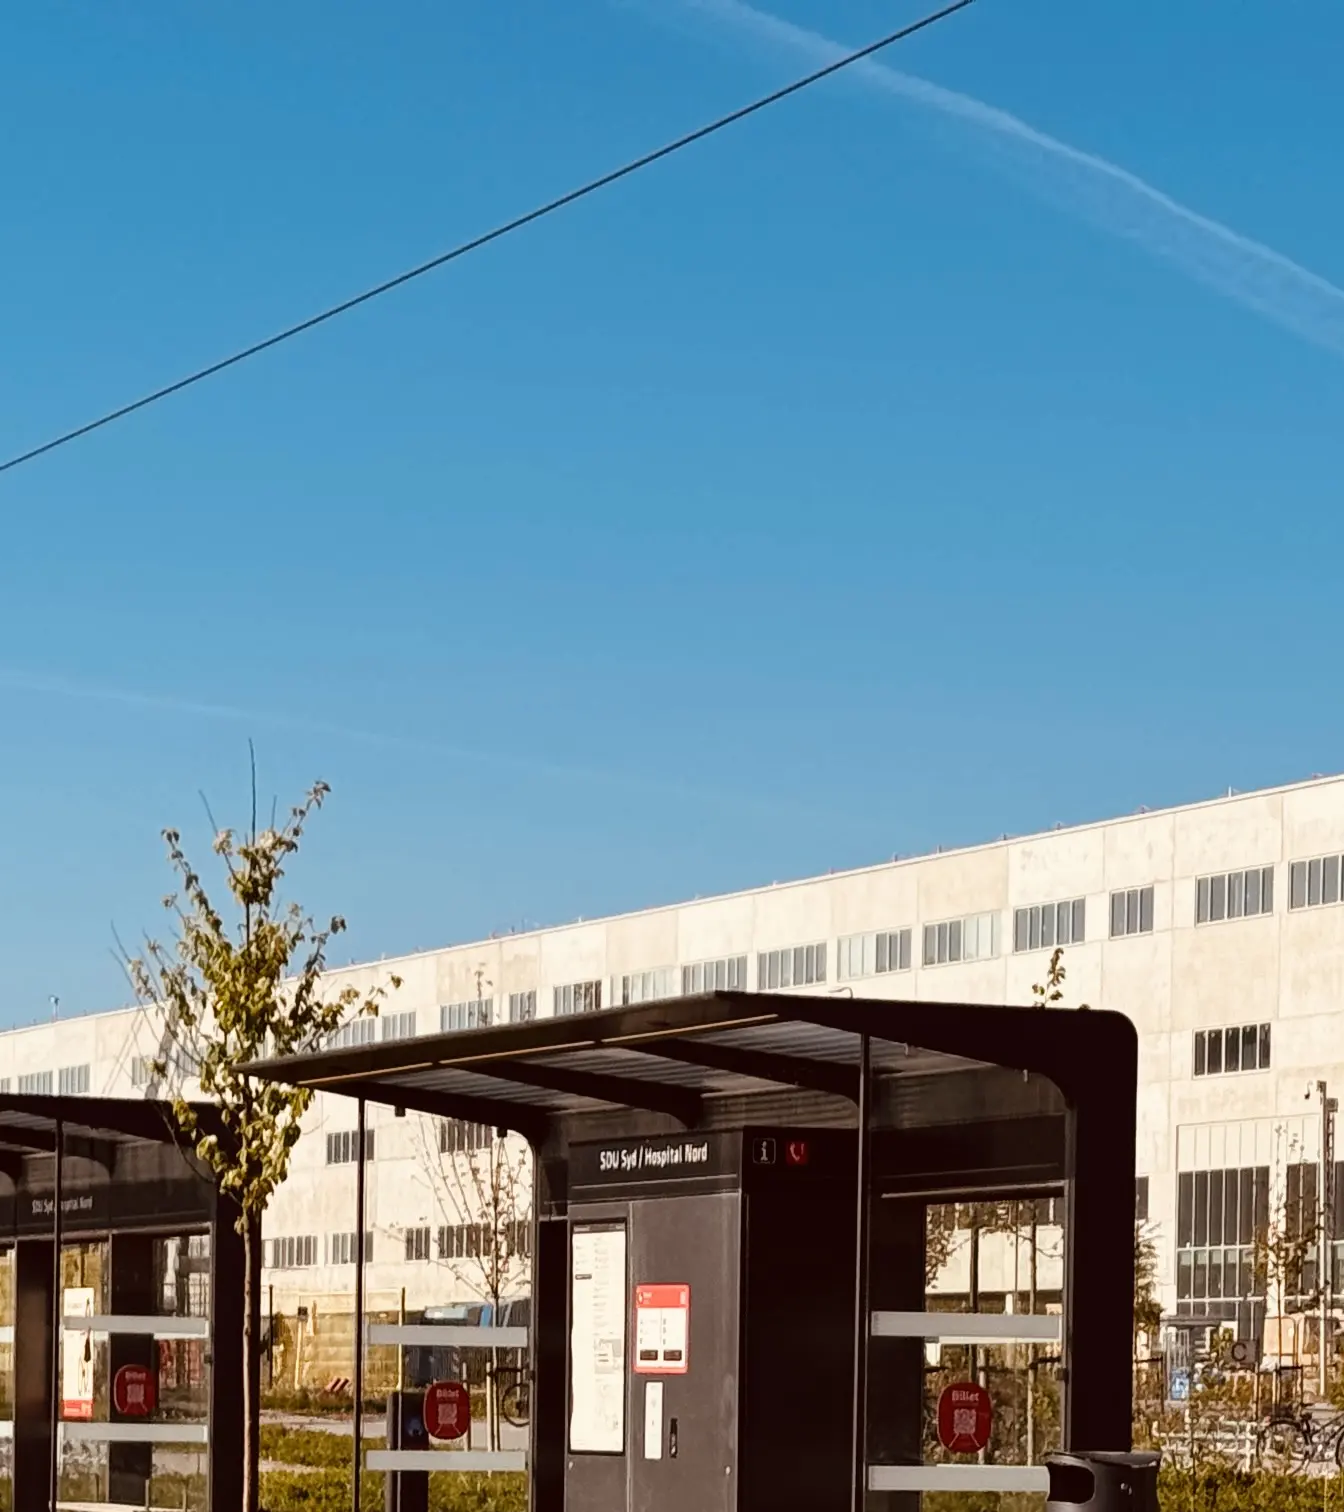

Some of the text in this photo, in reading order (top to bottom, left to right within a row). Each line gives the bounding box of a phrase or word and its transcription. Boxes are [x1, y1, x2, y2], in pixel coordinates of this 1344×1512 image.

[600, 1150, 619, 1171] SDU
[621, 1148, 637, 1171] Syd
[645, 1145, 683, 1168] Hospital
[685, 1142, 708, 1163] Nord
